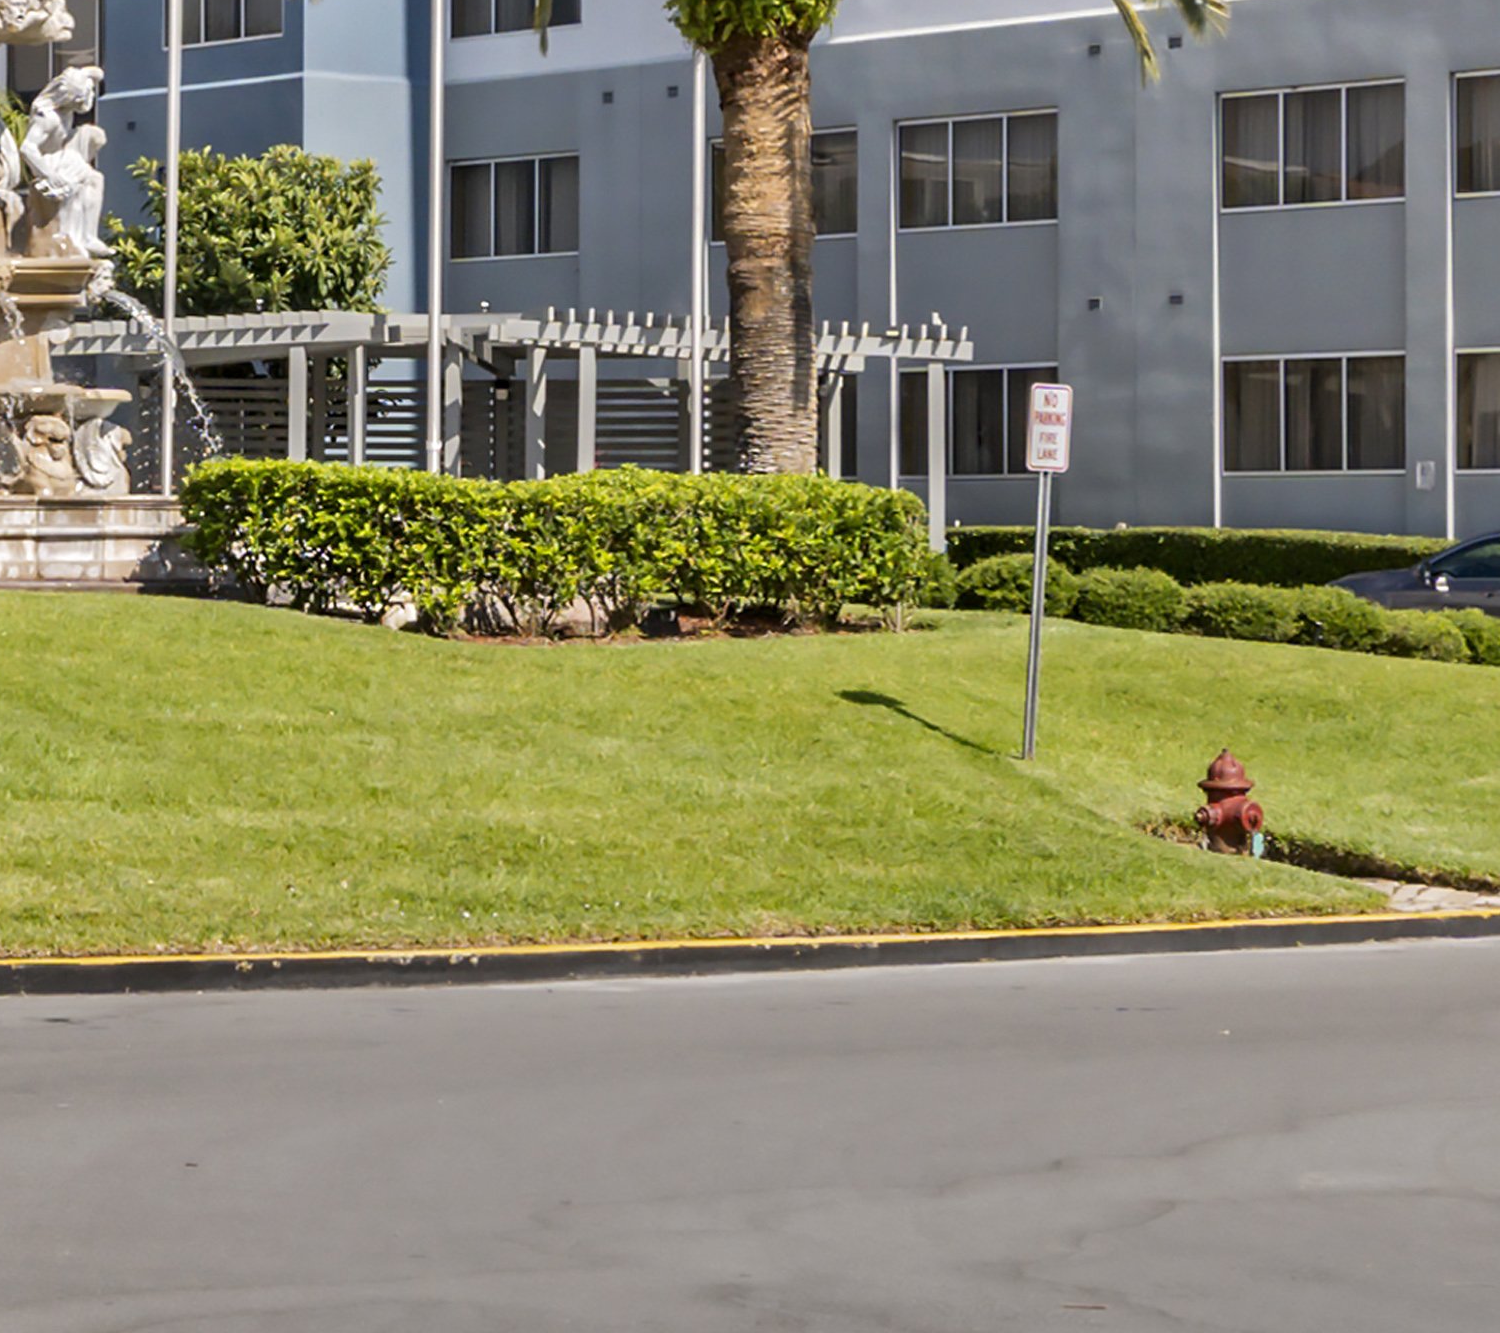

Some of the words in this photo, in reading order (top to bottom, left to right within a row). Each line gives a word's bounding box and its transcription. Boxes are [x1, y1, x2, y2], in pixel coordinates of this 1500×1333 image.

[1044, 394, 1058, 408] NO
[1033, 411, 1066, 426] PARKING
[1039, 432, 1057, 444] FIRE
[1037, 449, 1057, 460] LANE
